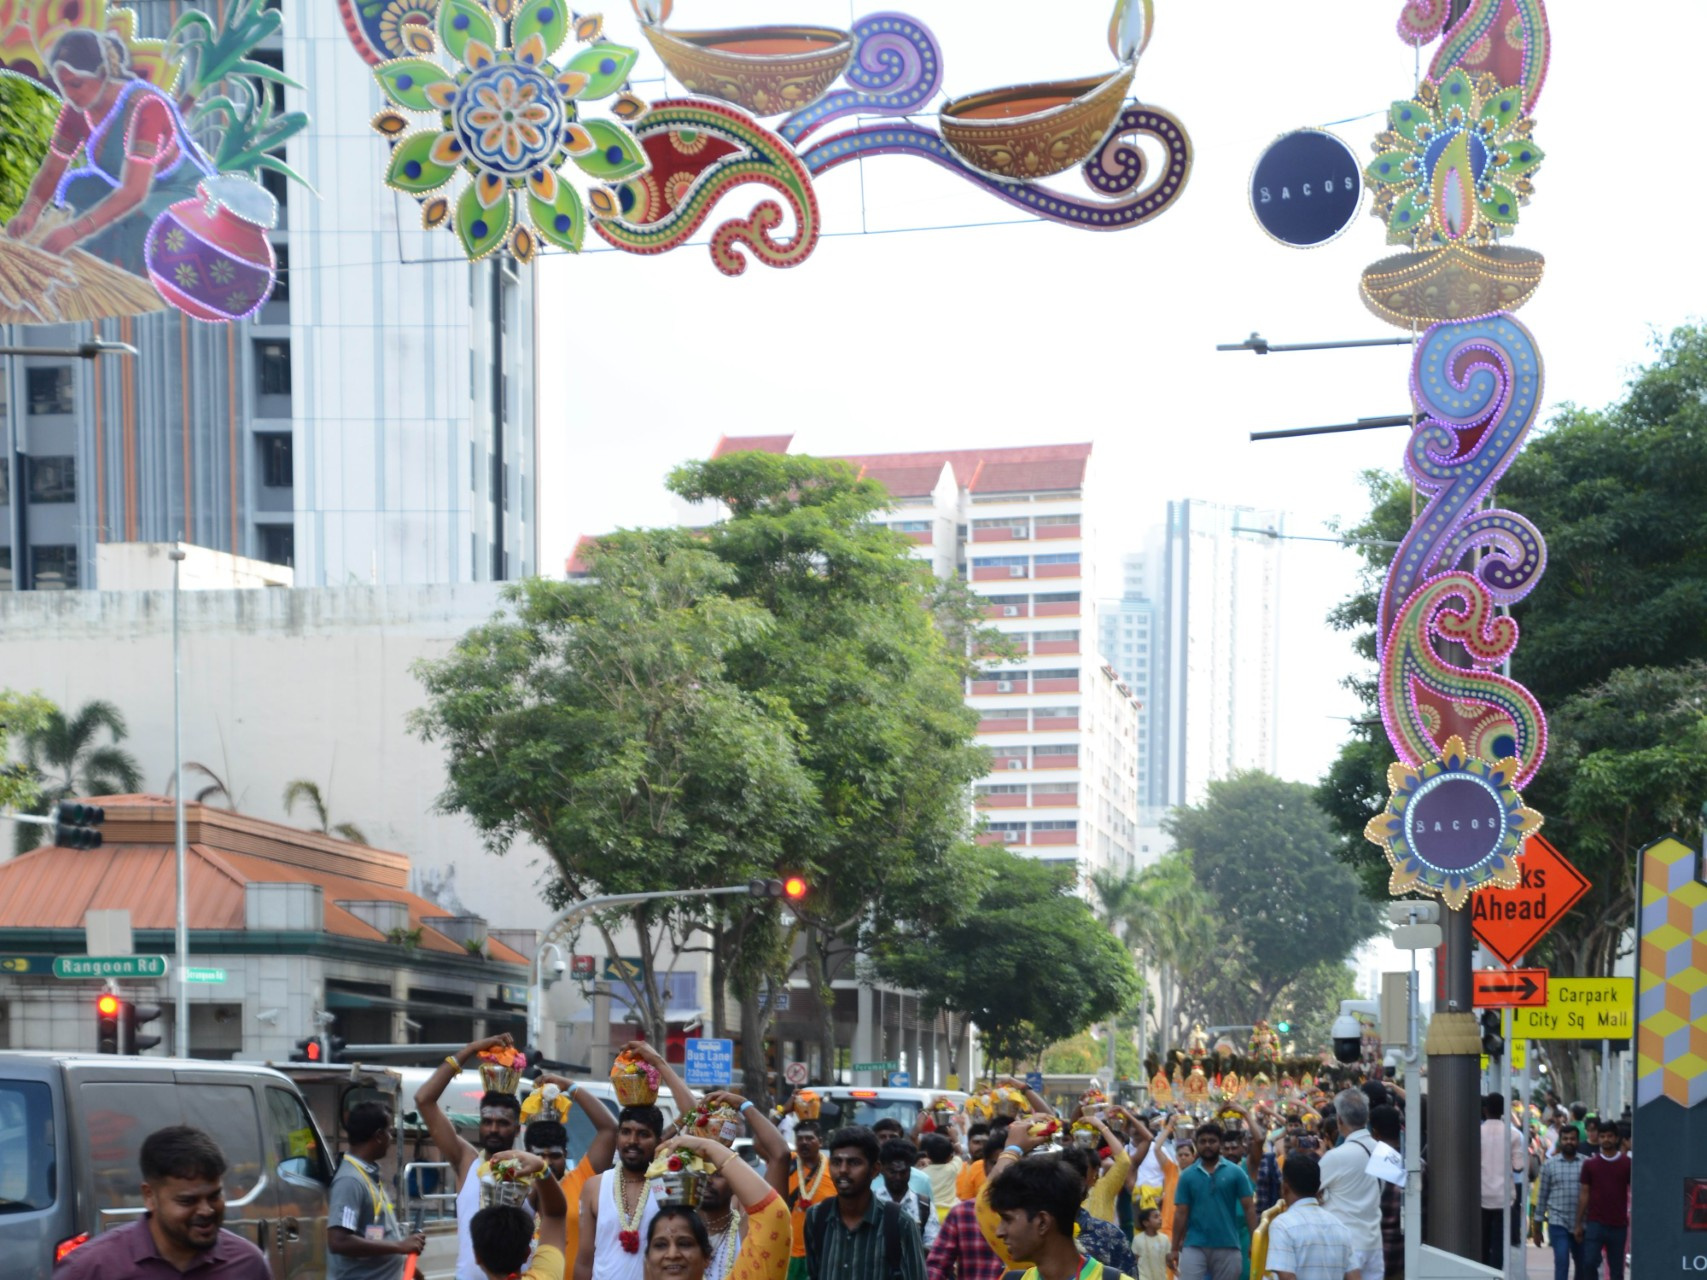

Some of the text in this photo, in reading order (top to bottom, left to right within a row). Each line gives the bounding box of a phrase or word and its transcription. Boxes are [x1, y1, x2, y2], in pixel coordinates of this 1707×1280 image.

[1473, 892, 1546, 920] Ahead
[63, 958, 157, 976] Rangoon Rd
[1559, 987, 1618, 1006] Carpark
[1529, 1011, 1627, 1031] City Sq Mall
[687, 1049, 730, 1061] Bus Lane
